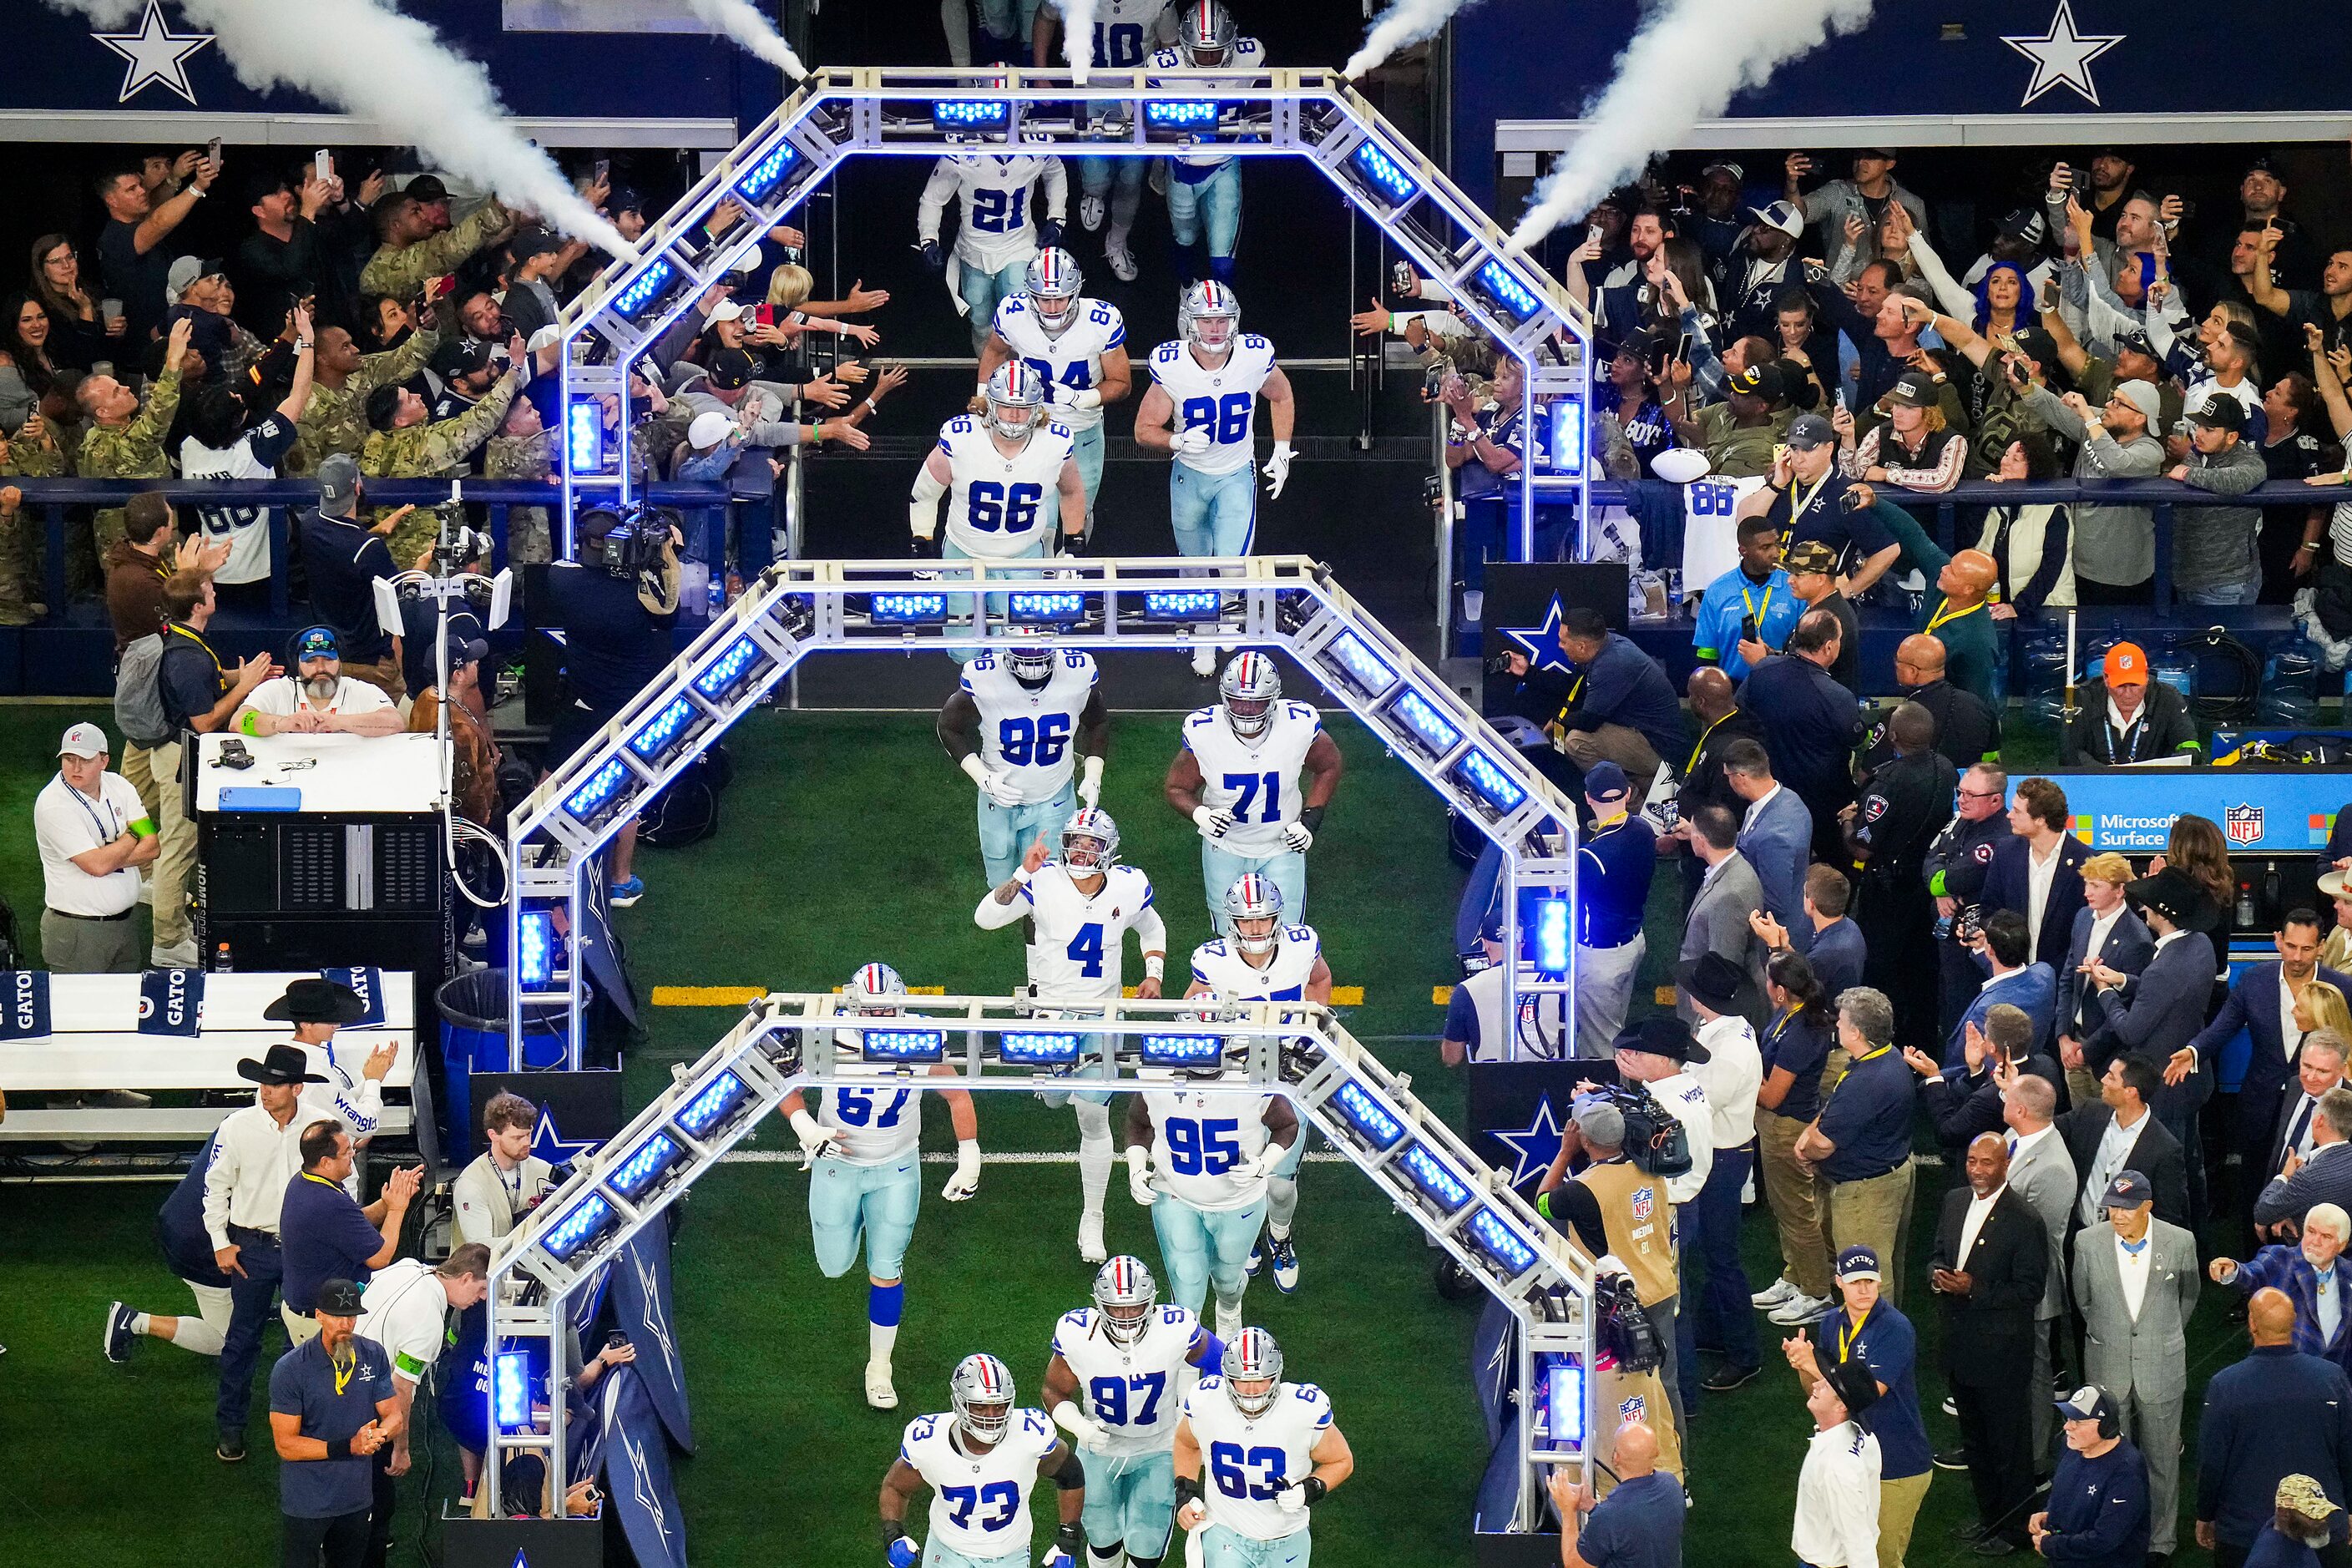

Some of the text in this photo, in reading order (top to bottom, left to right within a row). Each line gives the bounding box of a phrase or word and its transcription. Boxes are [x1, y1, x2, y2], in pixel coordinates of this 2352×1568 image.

[972, 186, 1026, 233] 21
[1182, 392, 1252, 444] 86
[969, 480, 1043, 534] 66
[1691, 483, 1734, 516] 88
[1222, 771, 1281, 824] 71
[2101, 831, 2165, 847] Surface
[2230, 822, 2259, 837] NFL
[1067, 923, 1104, 978] 4
[1166, 1116, 1240, 1176] 95
[1636, 1201, 1651, 1216] NFL
[1845, 1255, 1874, 1267] DALLAS
[1024, 1408, 1047, 1436] 73
[1090, 1371, 1166, 1426] 97
[913, 1414, 939, 1442] 73
[1211, 1440, 1286, 1500] 63
[940, 1480, 1019, 1532] 73
